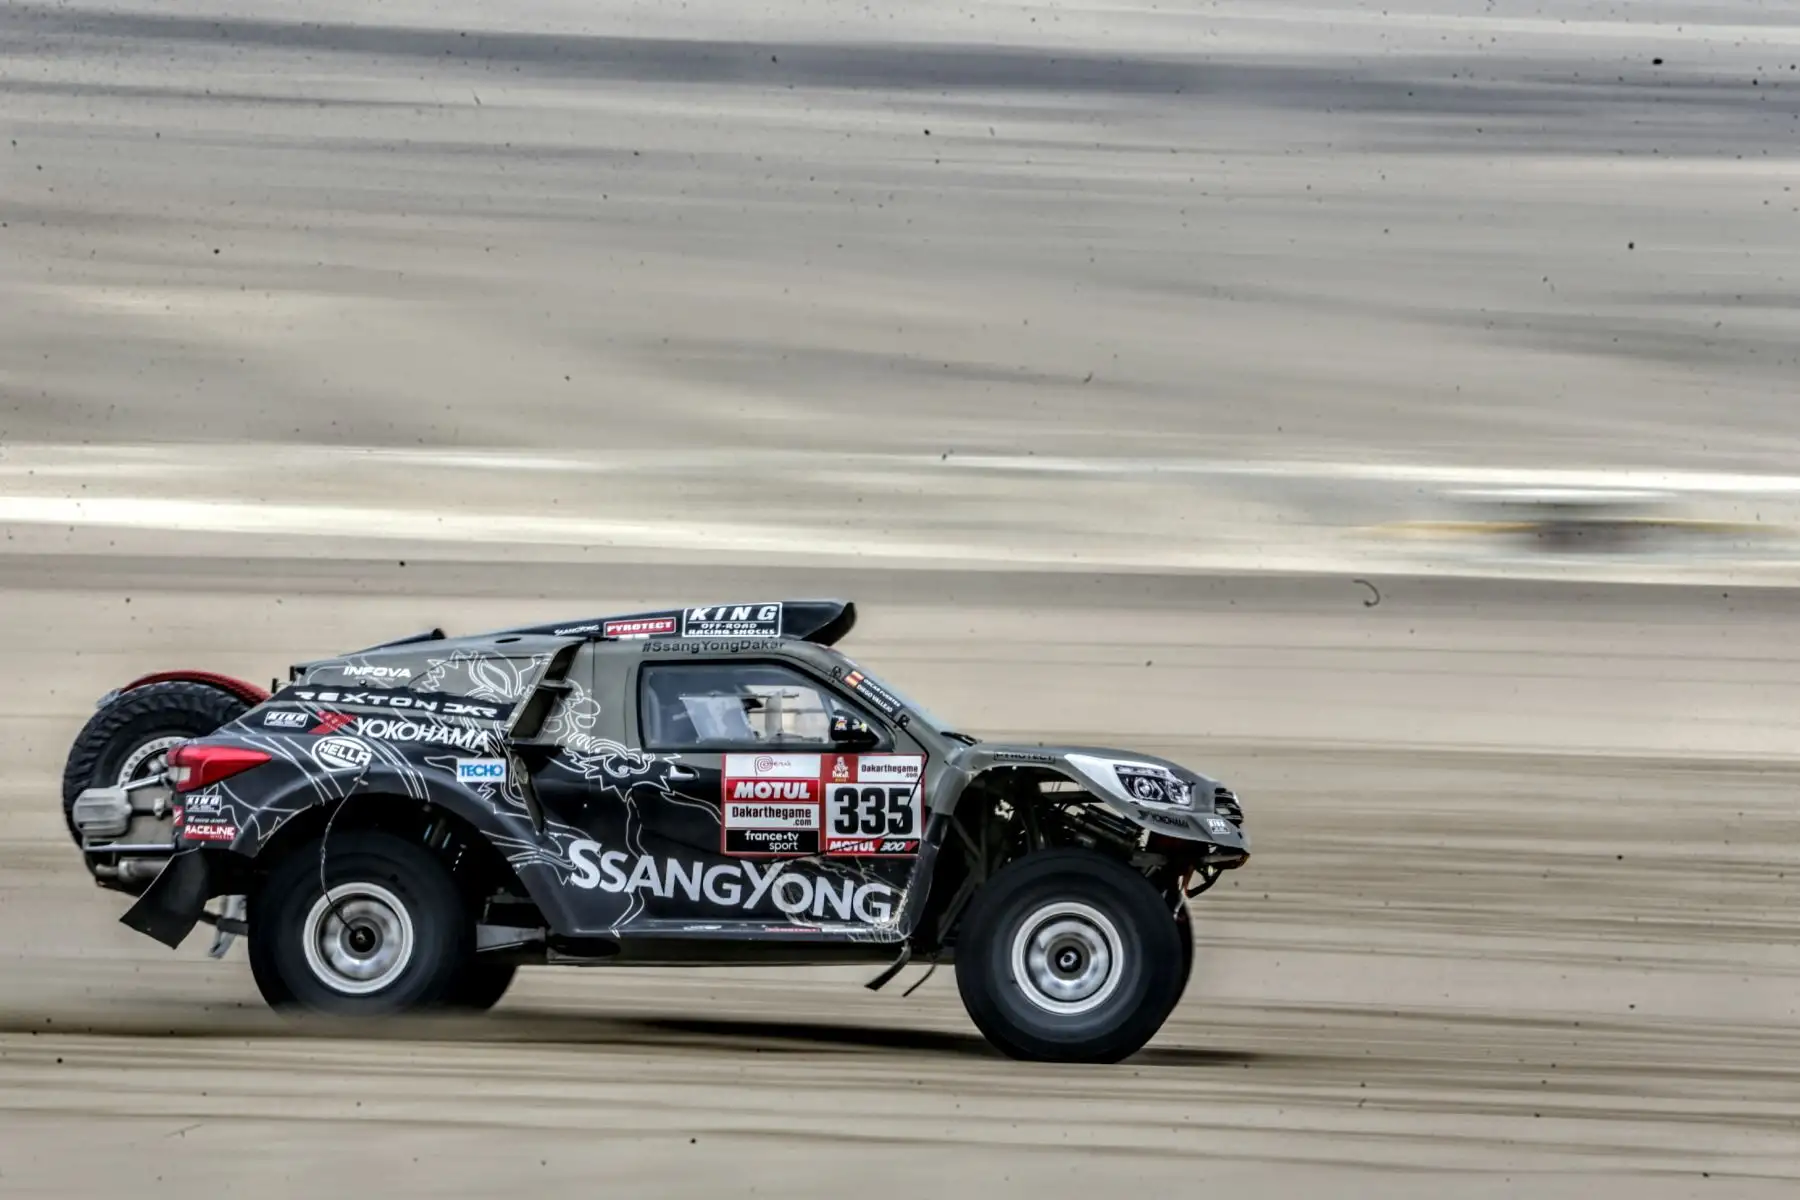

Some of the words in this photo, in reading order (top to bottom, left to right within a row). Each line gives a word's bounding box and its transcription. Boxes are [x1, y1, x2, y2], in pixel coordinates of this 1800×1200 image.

[689, 605, 778, 621] KING
[607, 621, 673, 633] PYROTECT
[642, 640, 786, 654] #SsangYongDakar
[342, 665, 412, 678] INFOVA
[294, 691, 438, 712] REXTON
[356, 716, 490, 753] YOKOHAMA
[318, 742, 373, 767] HELLA
[459, 764, 504, 777] TECHO
[861, 764, 918, 774] Dakarthegame
[733, 781, 811, 799] MOTUL
[731, 806, 812, 820] Dakarthegame
[833, 786, 914, 836] 335
[184, 824, 235, 836] RACELINE
[769, 842, 798, 852] sport
[829, 840, 876, 852] MOTUL
[569, 839, 893, 925] SSANGYONG
